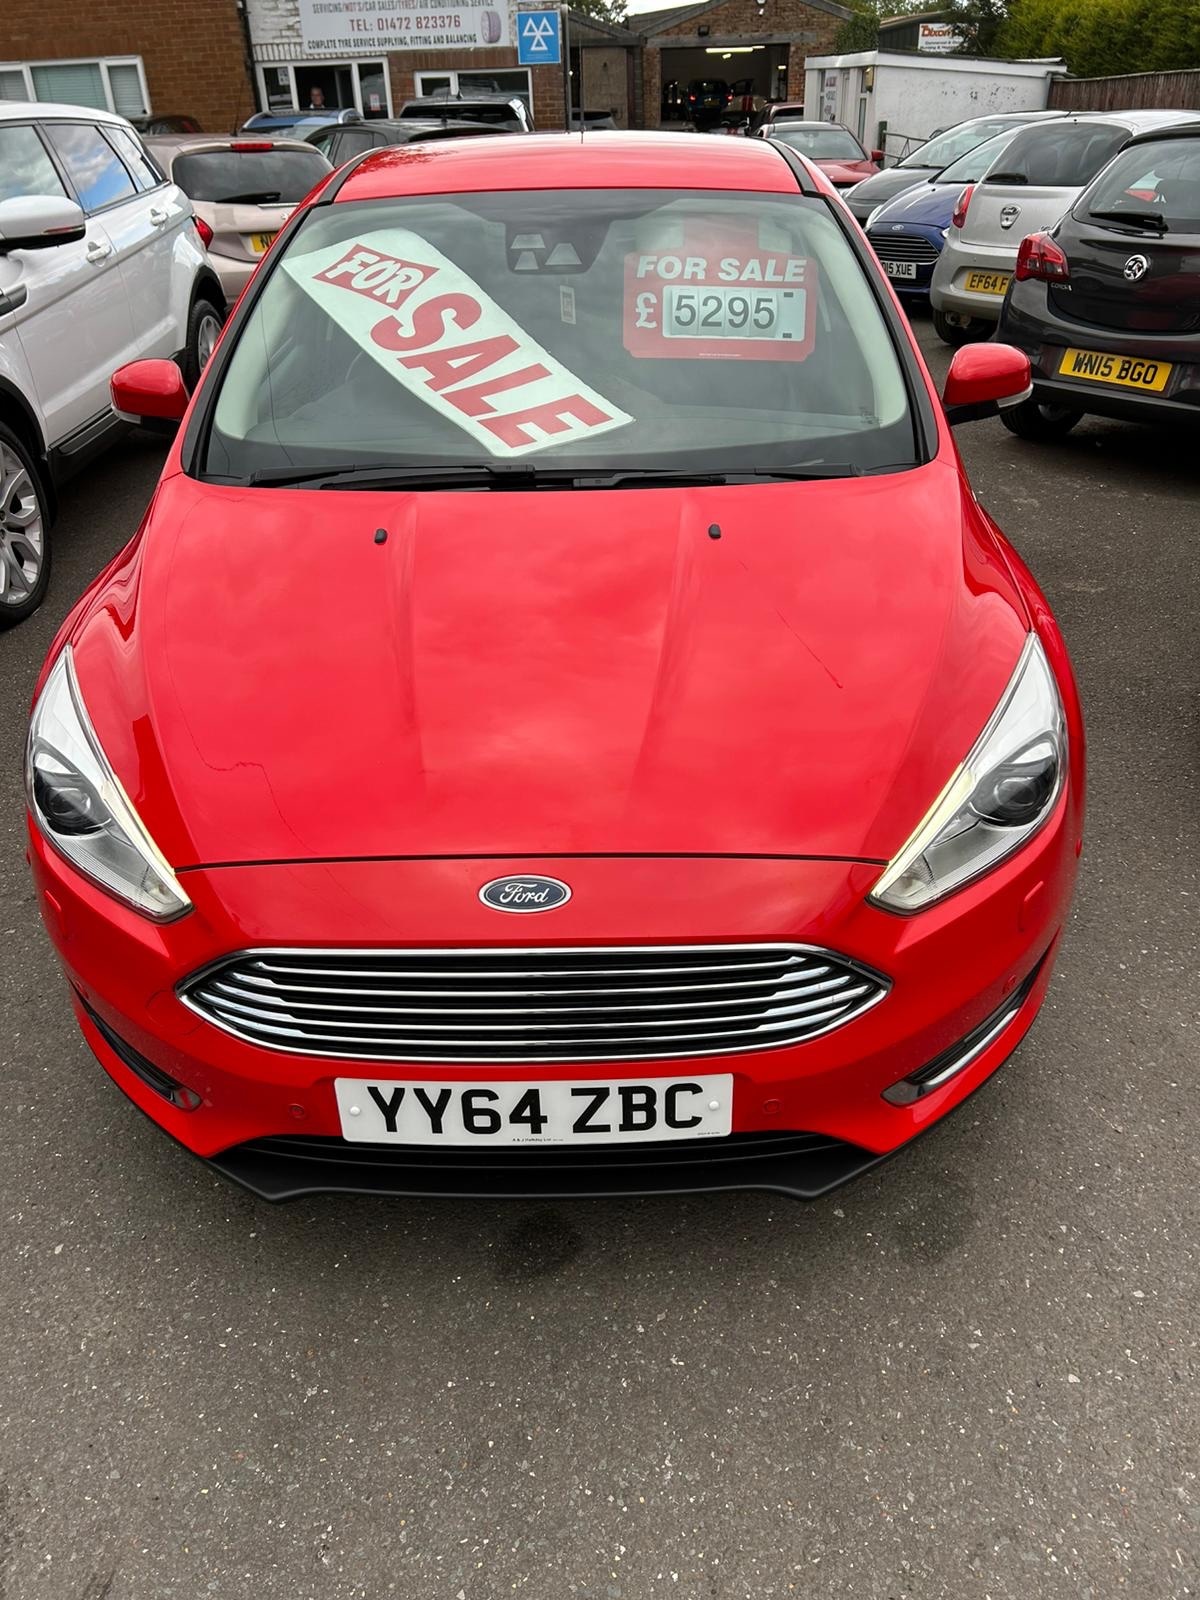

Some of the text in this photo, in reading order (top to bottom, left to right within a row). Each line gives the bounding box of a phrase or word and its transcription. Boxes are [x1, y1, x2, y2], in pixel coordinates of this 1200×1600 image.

[349, 15, 461, 32] TEL: 01472 823376
[308, 39, 337, 49] COMPLETE
[338, 39, 352, 48] TYRE
[353, 37, 376, 48] SERVICE
[410, 35, 432, 46] FITTING
[433, 35, 444, 44] AND
[446, 33, 477, 44] BALANCING
[636, 255, 808, 282] FOR SALE
[896, 263, 912, 275] XUE
[969, 273, 998, 291] EF64
[635, 291, 776, 330] £ 5295
[325, 251, 614, 449] FOR SALE
[1072, 353, 1158, 385] WN15 BGO
[499, 882, 550, 904] Ford
[367, 1082, 704, 1135] YY64 ZBC
